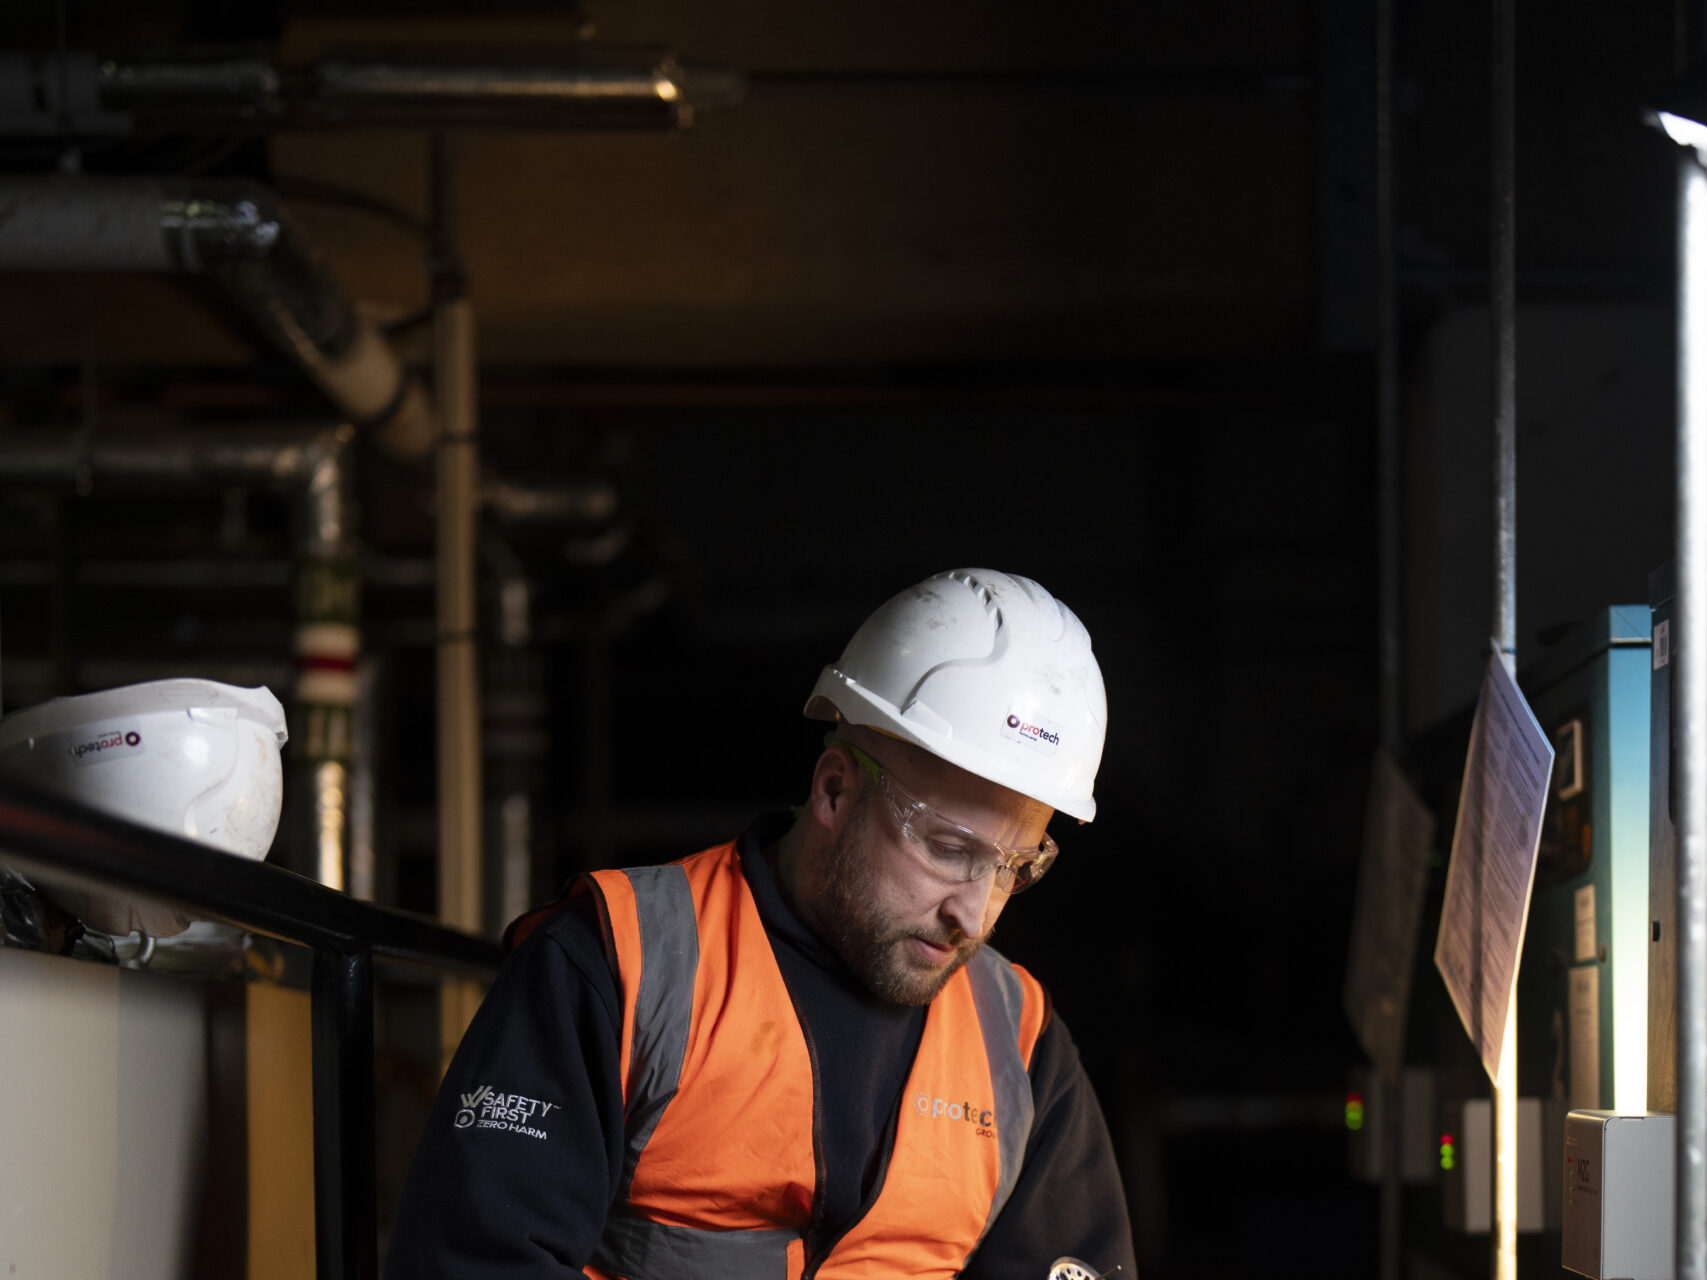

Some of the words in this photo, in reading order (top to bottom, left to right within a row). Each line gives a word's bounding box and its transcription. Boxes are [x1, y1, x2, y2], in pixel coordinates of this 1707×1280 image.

[73, 732, 123, 757] protech
[1020, 722, 1060, 745] protech
[481, 1106, 532, 1123] FIRST
[932, 1098, 995, 1127] protec
[476, 1120, 507, 1129] ZERO
[509, 1123, 547, 1139] HARM
